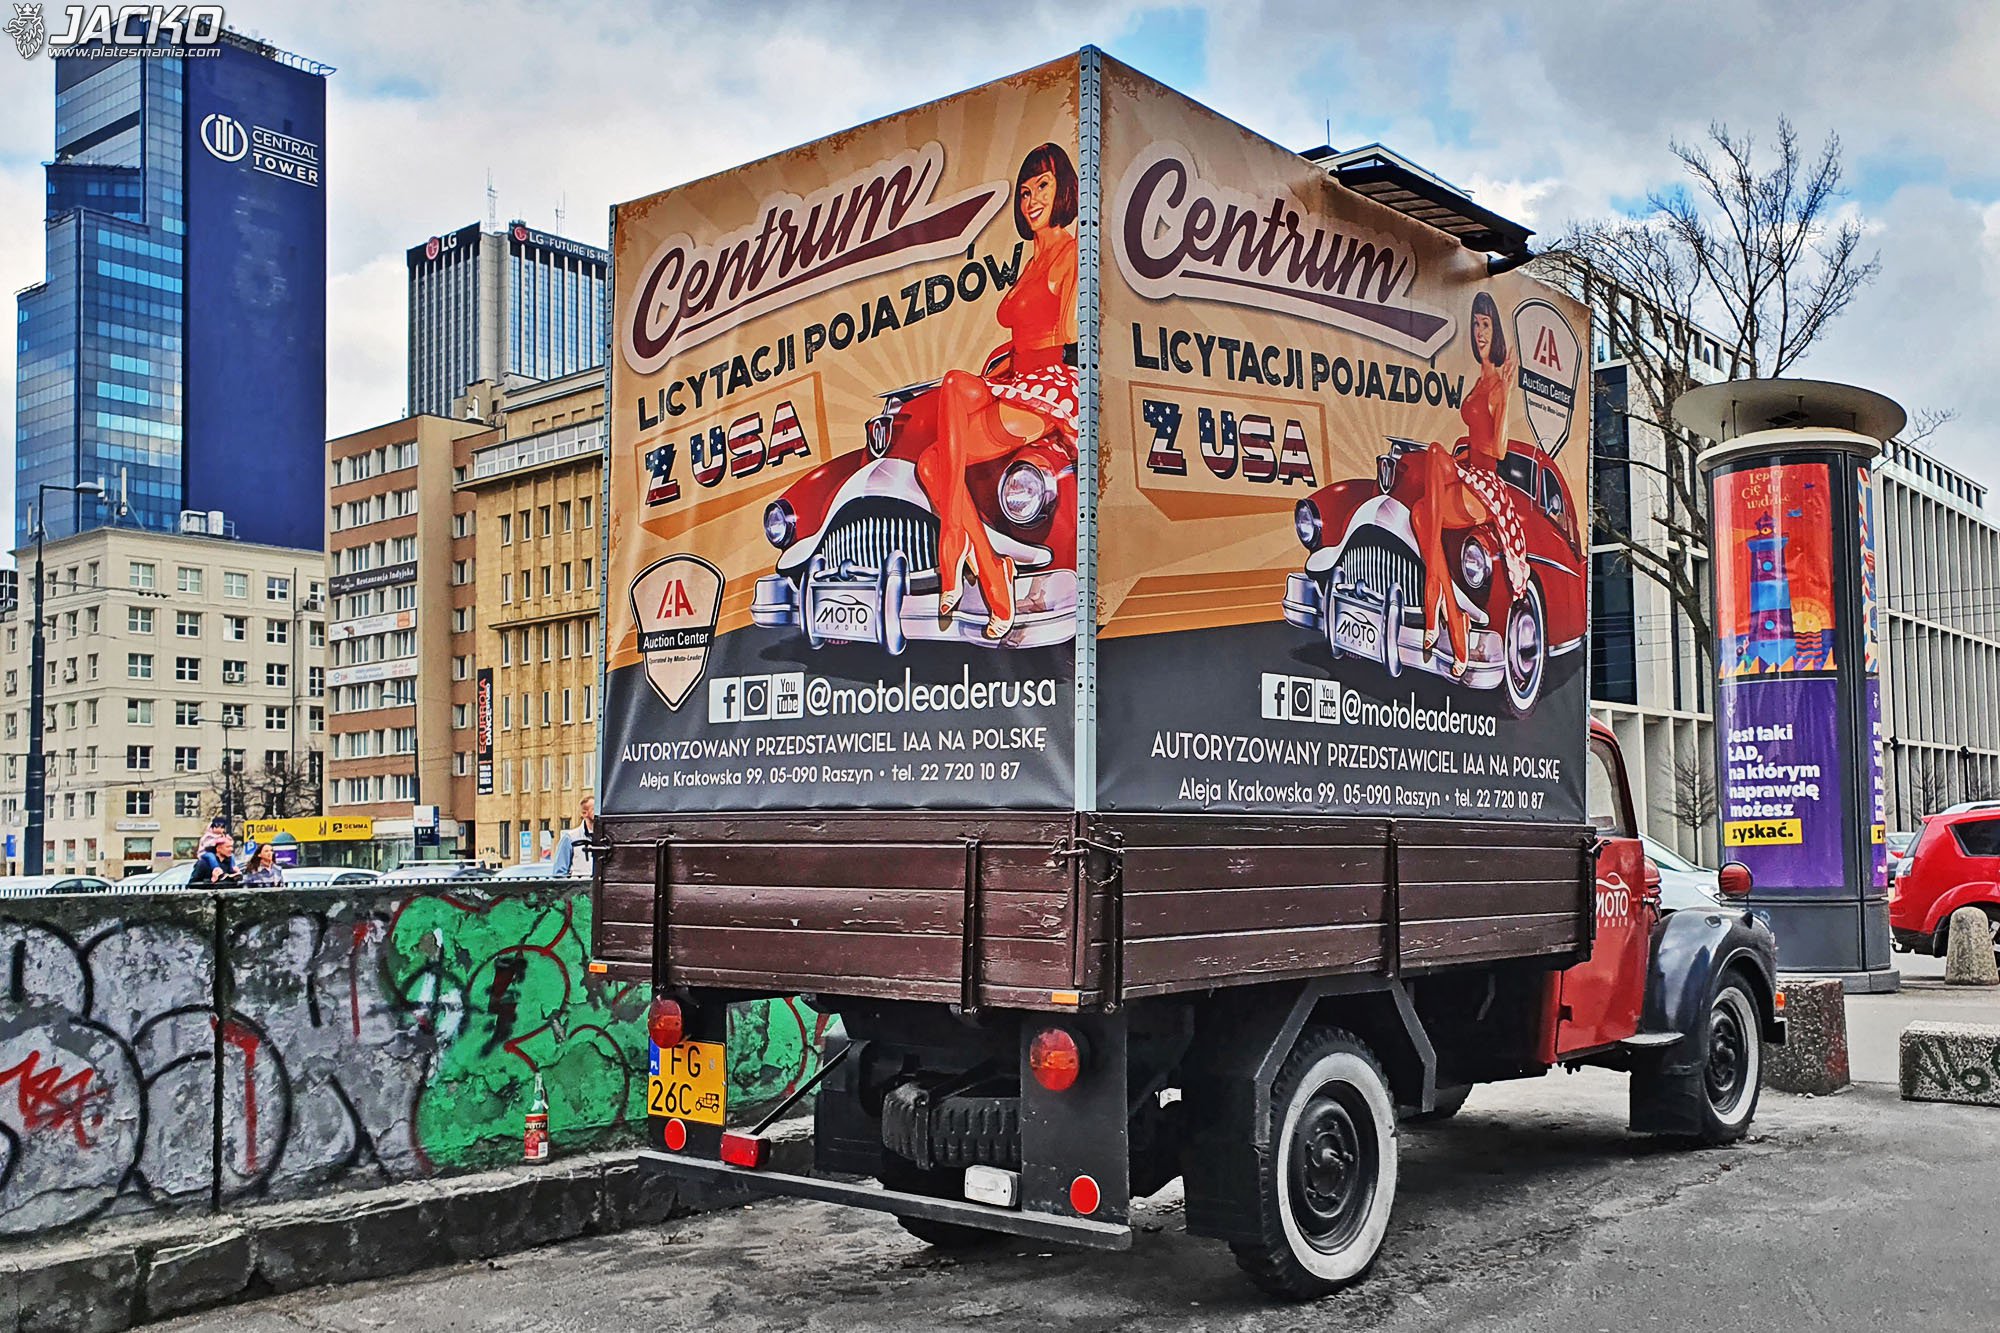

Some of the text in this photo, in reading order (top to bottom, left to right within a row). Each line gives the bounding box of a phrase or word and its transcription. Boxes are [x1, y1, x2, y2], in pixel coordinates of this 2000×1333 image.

[252, 130, 318, 160] CENTRAL
[252, 152, 318, 182] TOWER
[441, 232, 457, 252] LG
[1124, 157, 1409, 303] Centrum
[529, 233, 609, 264] LG FUTURE IS HE
[632, 156, 935, 360] Centrum
[638, 241, 1025, 432] LICYTACJI POJAZDÓW
[1132, 322, 1465, 410] LICYTACJI POJAZDÓW
[1522, 373, 1571, 404] Auction Center
[644, 400, 811, 507] Z USA
[1143, 399, 1317, 488] Z USA
[1741, 484, 1761, 499] Cię
[816, 606, 868, 625] MOTO
[643, 631, 709, 650] Auction Center
[1337, 619, 1376, 643] MOTO
[780, 678, 796, 693] You
[806, 664, 1056, 717] @motoleaderusa
[1321, 684, 1334, 699] You
[479, 678, 487, 755] EGURROLA
[777, 694, 798, 713] Tube
[1319, 701, 1336, 719] Tube
[1342, 689, 1497, 737] @motoleaderusa
[621, 727, 1047, 762] AUTORYZOWANY PRZEDSTAWICIEL IAA NA POLSKĘ
[1757, 724, 1793, 742] taki
[1151, 731, 1561, 784] AUTORYZOWANY PRZEDSTAWICIEL IAA NA POLSKĘ
[1729, 763, 1820, 782] na którym
[639, 772, 669, 791] Aleja
[673, 768, 741, 788] Krakowska
[769, 766, 818, 784] 05-090
[822, 764, 873, 784] Raszyn
[892, 764, 915, 781] tel.
[920, 764, 939, 781] 22
[945, 763, 974, 781] 720
[980, 762, 995, 780] 10
[1000, 762, 1021, 780] 87
[1729, 781, 1820, 801] naprawdę
[1178, 777, 1221, 805] Aleja
[1228, 778, 1312, 803] Krakowska
[1343, 783, 1391, 805] 05-090
[1396, 786, 1441, 809] Raszyn
[1454, 788, 1473, 807] tel.
[1476, 789, 1491, 807] 22
[1494, 790, 1515, 809] 720
[1517, 791, 1528, 809] 10
[1531, 792, 1544, 810] 87
[1730, 801, 1795, 818] możesz
[1596, 890, 1628, 918] MOTO
[650, 1061, 659, 1070] PL
[671, 1044, 701, 1078] FG
[651, 1079, 692, 1115] 26C
